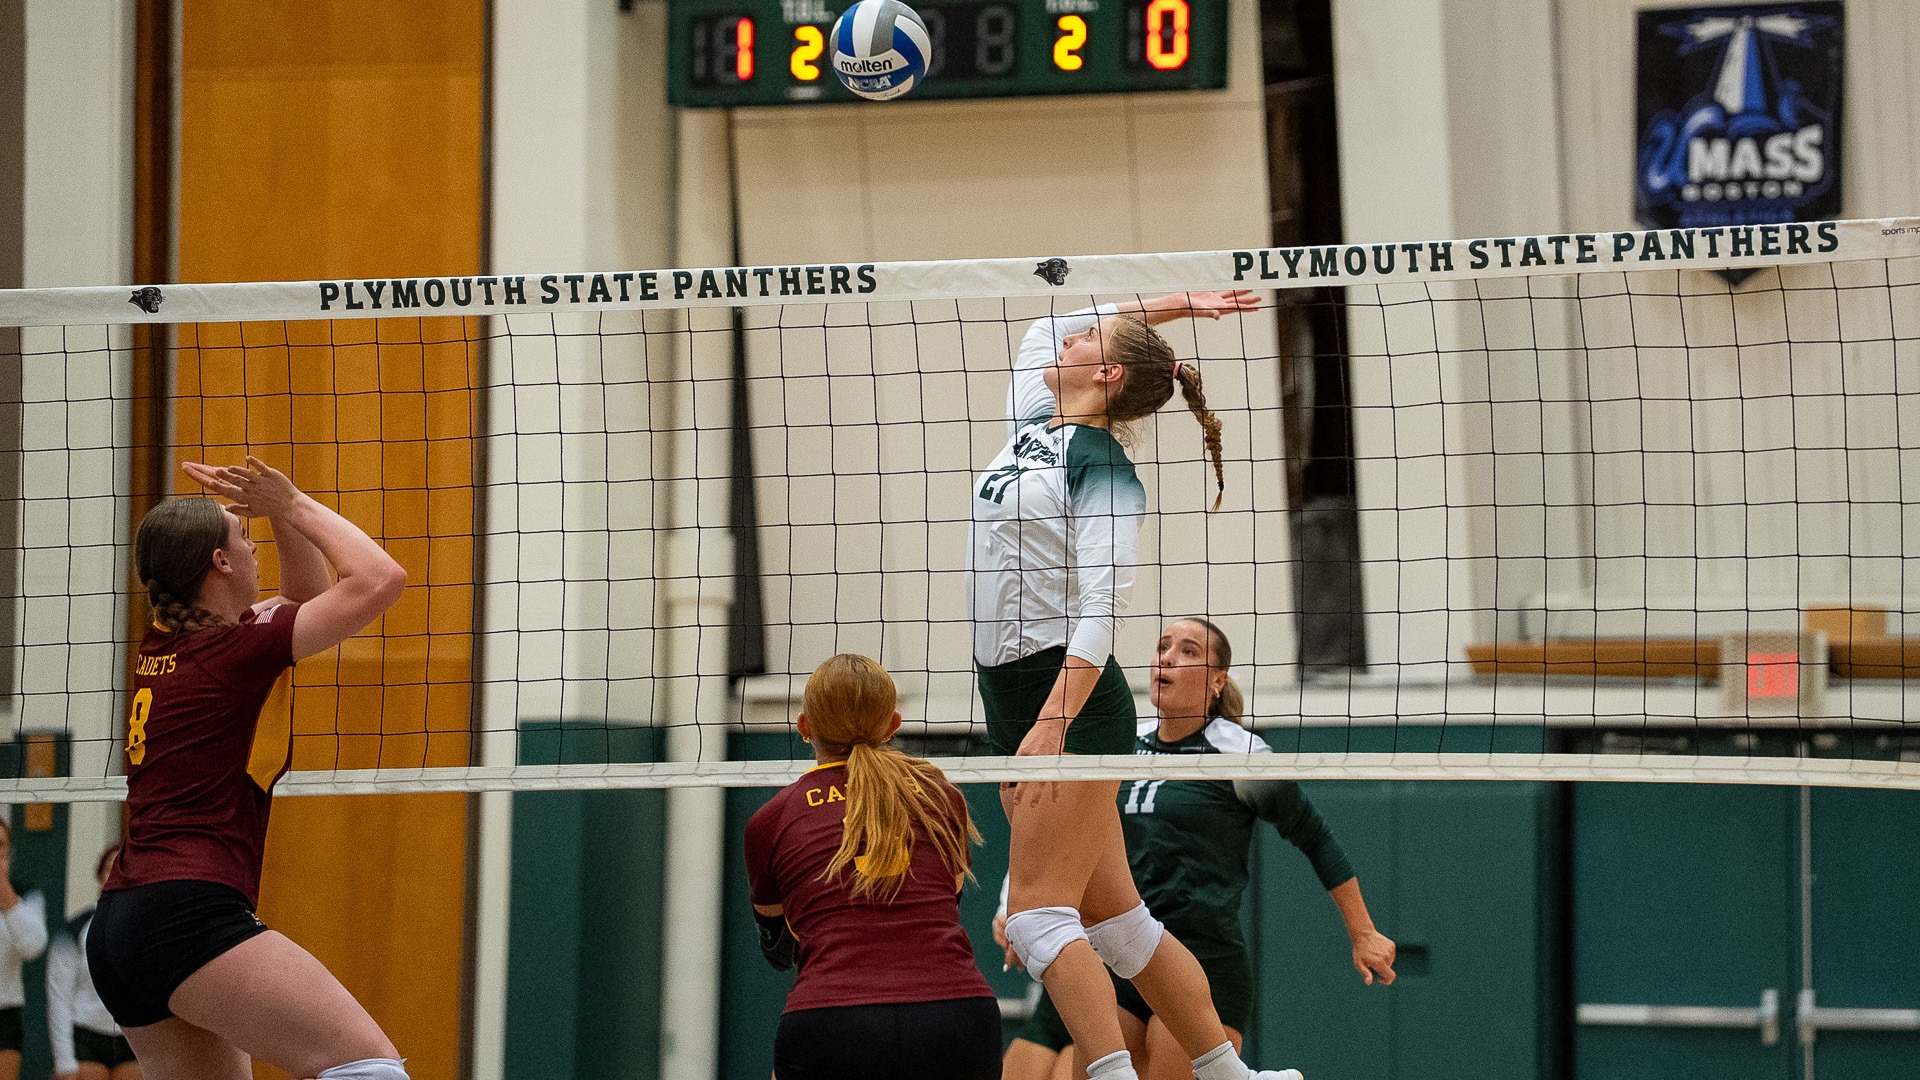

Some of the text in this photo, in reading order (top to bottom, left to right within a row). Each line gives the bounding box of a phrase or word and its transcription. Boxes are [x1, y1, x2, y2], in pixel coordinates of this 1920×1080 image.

[736, 17, 754, 81] 1
[790, 25, 824, 81] 2
[1053, 15, 1088, 70] 2
[1146, 0, 1190, 70] 0
[841, 59, 893, 73] molten
[848, 76, 891, 90] NCAA
[1232, 222, 1839, 281] PLYMOUTH STATE PANTHERS
[1881, 227, 1906, 237] sports
[319, 264, 877, 310] PLYMOUTH STATE PANTHERS
[136, 653, 177, 676] CADETS
[125, 687, 153, 765] 8
[1124, 780, 1166, 814] 11
